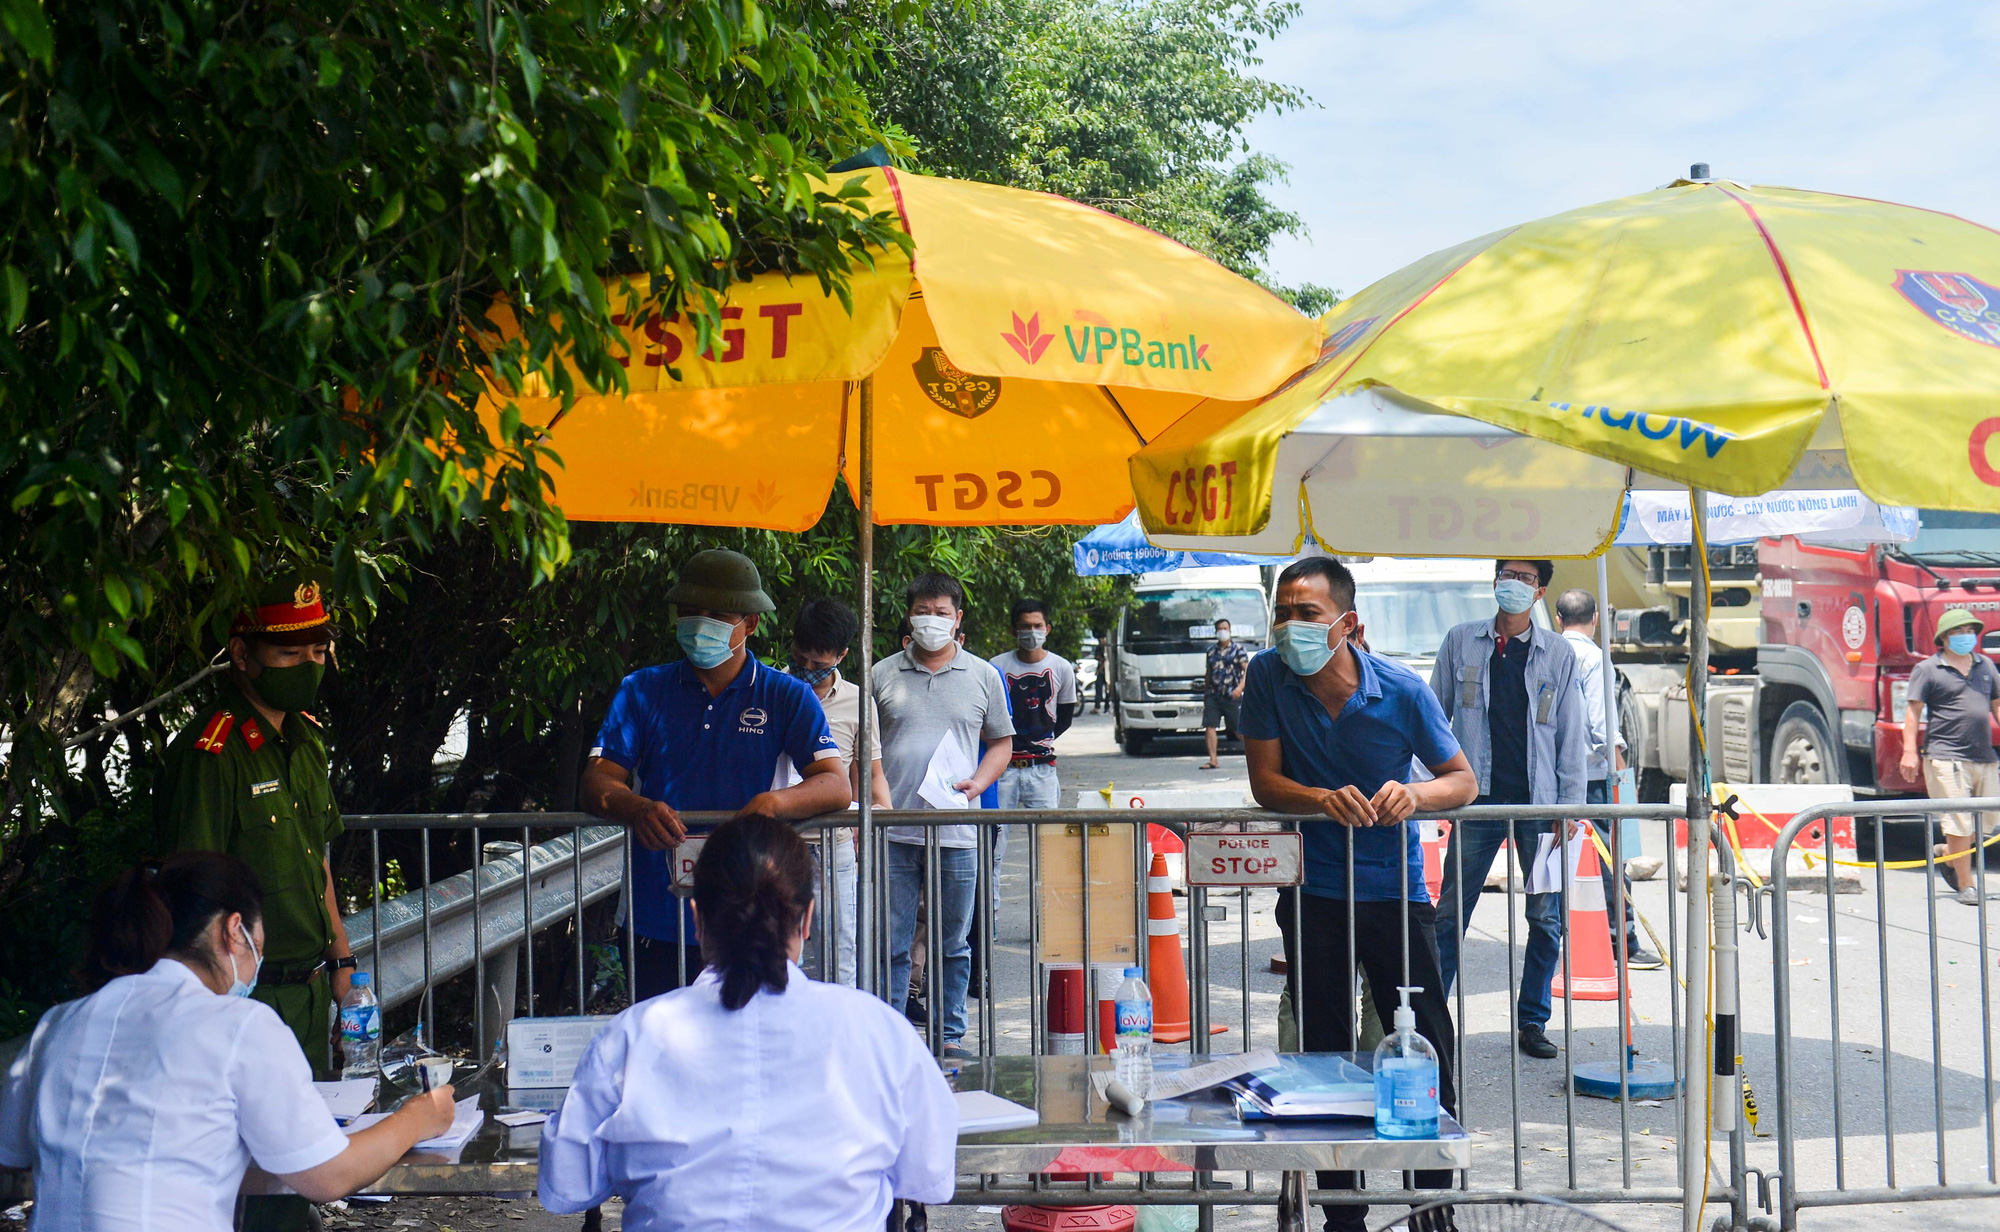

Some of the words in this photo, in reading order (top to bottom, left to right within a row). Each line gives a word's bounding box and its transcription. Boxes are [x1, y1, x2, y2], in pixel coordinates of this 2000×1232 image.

[1063, 324, 1212, 372] VPBank
[1164, 460, 1237, 526] CSGT
[1830, 495, 1858, 511] LẠNH
[1101, 548, 1133, 562] Hotline:
[738, 726, 764, 735] HINO
[1218, 839, 1270, 849] POLICE
[1211, 857, 1278, 874] STOP
[1120, 1015, 1149, 1026] laVie
